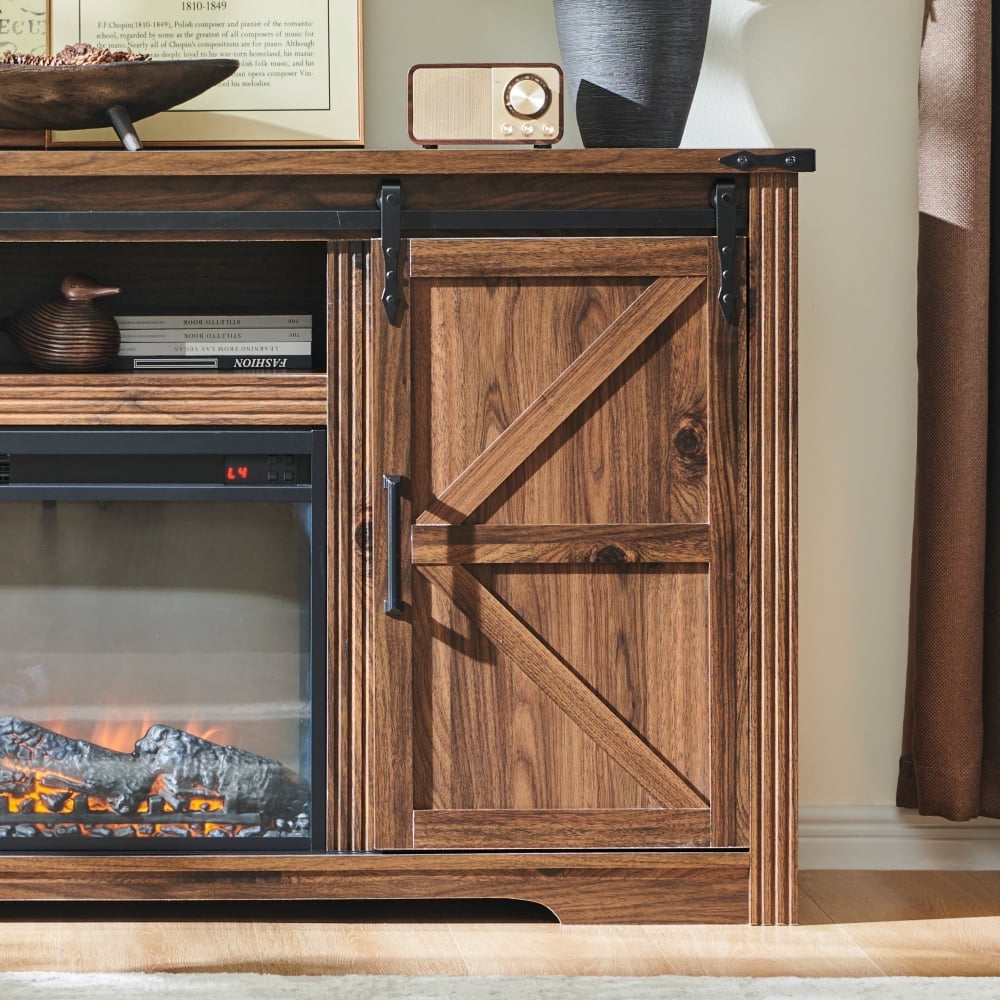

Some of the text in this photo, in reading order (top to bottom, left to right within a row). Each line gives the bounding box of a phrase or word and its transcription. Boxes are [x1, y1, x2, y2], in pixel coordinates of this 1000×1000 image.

[181, 1, 227, 12] 1810-1849
[175, 20, 193, 28] Polish
[194, 22, 225, 30] composer
[228, 20, 239, 28] and
[264, 20, 271, 28] of
[273, 19, 281, 27] the
[284, 20, 313, 28] romantic
[120, 31, 147, 41] regarded
[149, 31, 157, 41] by
[195, 31, 220, 41] greatest
[222, 30, 229, 38] of
[231, 30, 239, 38] all
[241, 31, 273, 40] composers
[276, 30, 282, 38] of
[304, 29, 315, 37] for
[150, 40, 159, 48] all
[161, 40, 168, 48] of
[169, 40, 196, 50] Chopin's
[198, 41, 239, 50] compositions
[252, 40, 262, 48] for
[285, 39, 315, 49] Although
[208, 50, 218, 58] his
[283, 49, 293, 57] his
[254, 59, 268, 67] folk
[292, 59, 304, 67] and
[305, 58, 315, 67] his
[247, 71, 265, 80] opera
[267, 71, 297, 80] composer
[231, 79, 241, 87] his
[201, 345, 216, 353] LAS
[233, 358, 288, 368] FASHION
